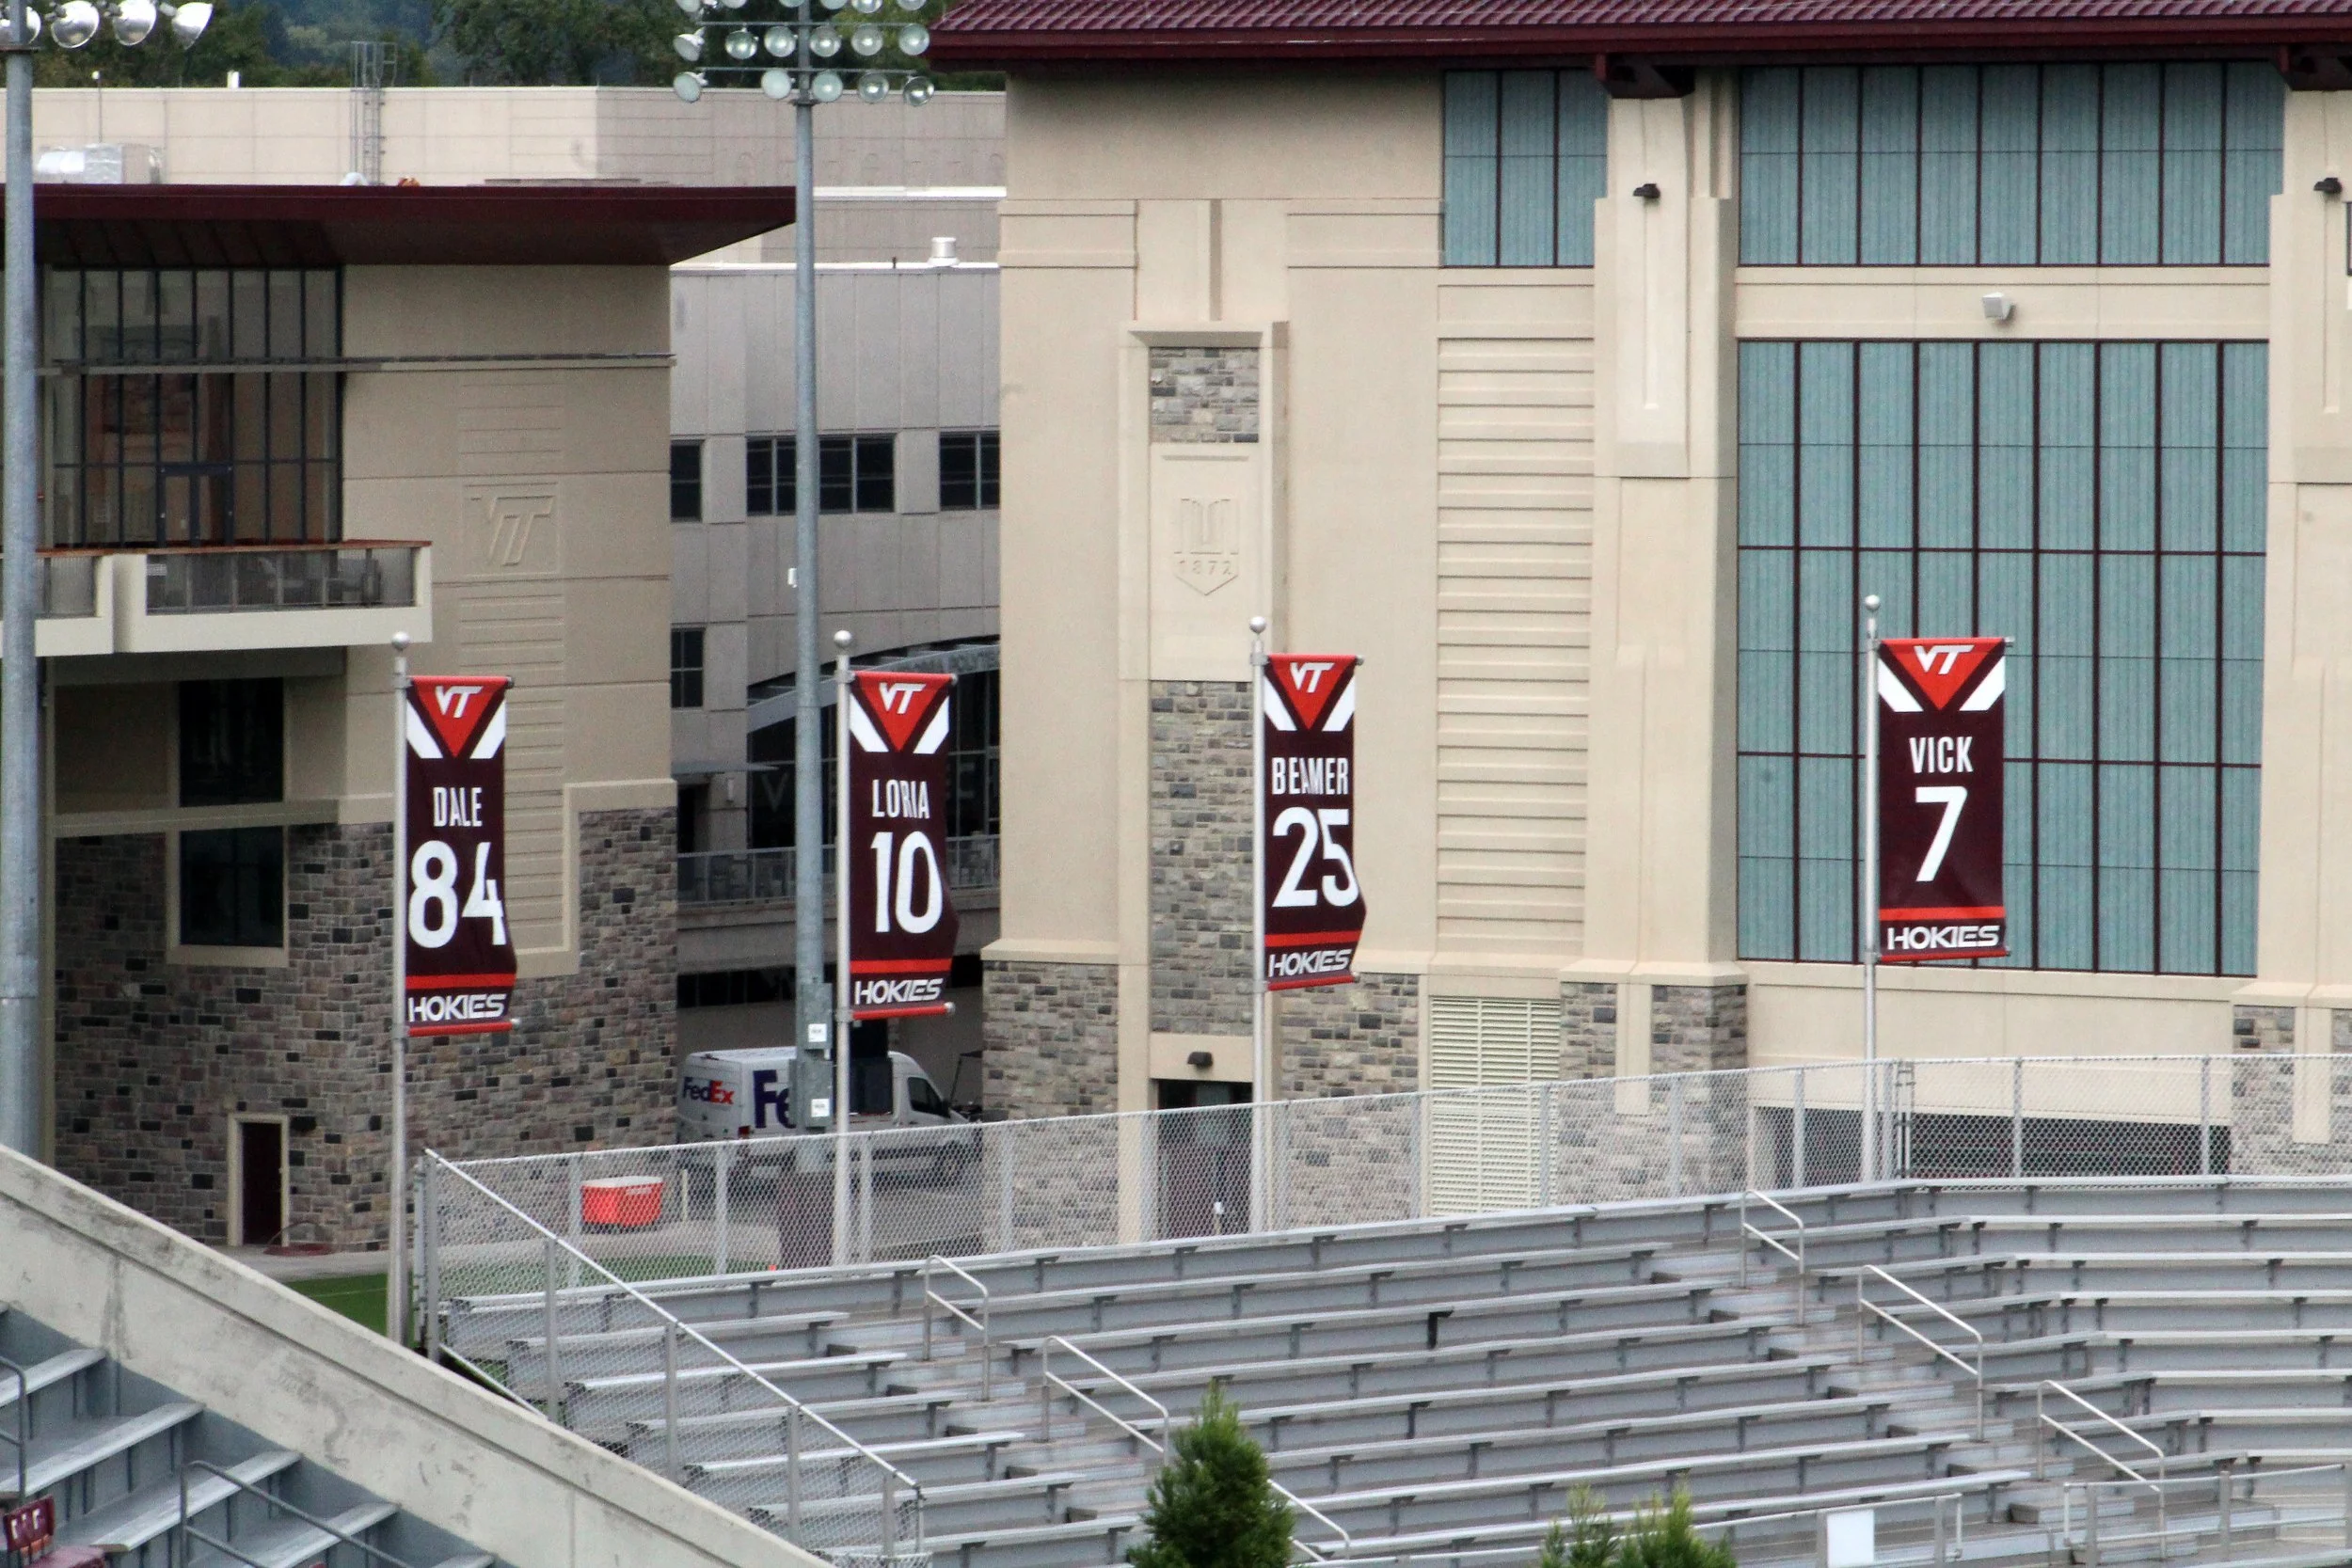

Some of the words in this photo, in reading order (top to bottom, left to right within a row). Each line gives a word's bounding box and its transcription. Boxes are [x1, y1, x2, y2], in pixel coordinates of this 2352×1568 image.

[1915, 645, 1974, 674] VT
[1291, 662, 1334, 692] VT
[436, 687, 482, 718] VT
[880, 683, 926, 714] VT
[1910, 736, 1973, 773] VICK
[1272, 757, 1349, 795] BEAMER
[434, 787, 482, 827] DALE
[872, 780, 930, 818] LORIA
[1915, 786, 1967, 881] 7
[1272, 806, 1359, 907] 25
[408, 841, 506, 948] 84
[871, 832, 942, 933] 10
[1887, 926, 1999, 950] HOKIES
[1268, 949, 1353, 977] HOKIES
[855, 978, 943, 1005] HOKIES
[408, 994, 506, 1022] HOKIES
[682, 1076, 734, 1105] FedEx
